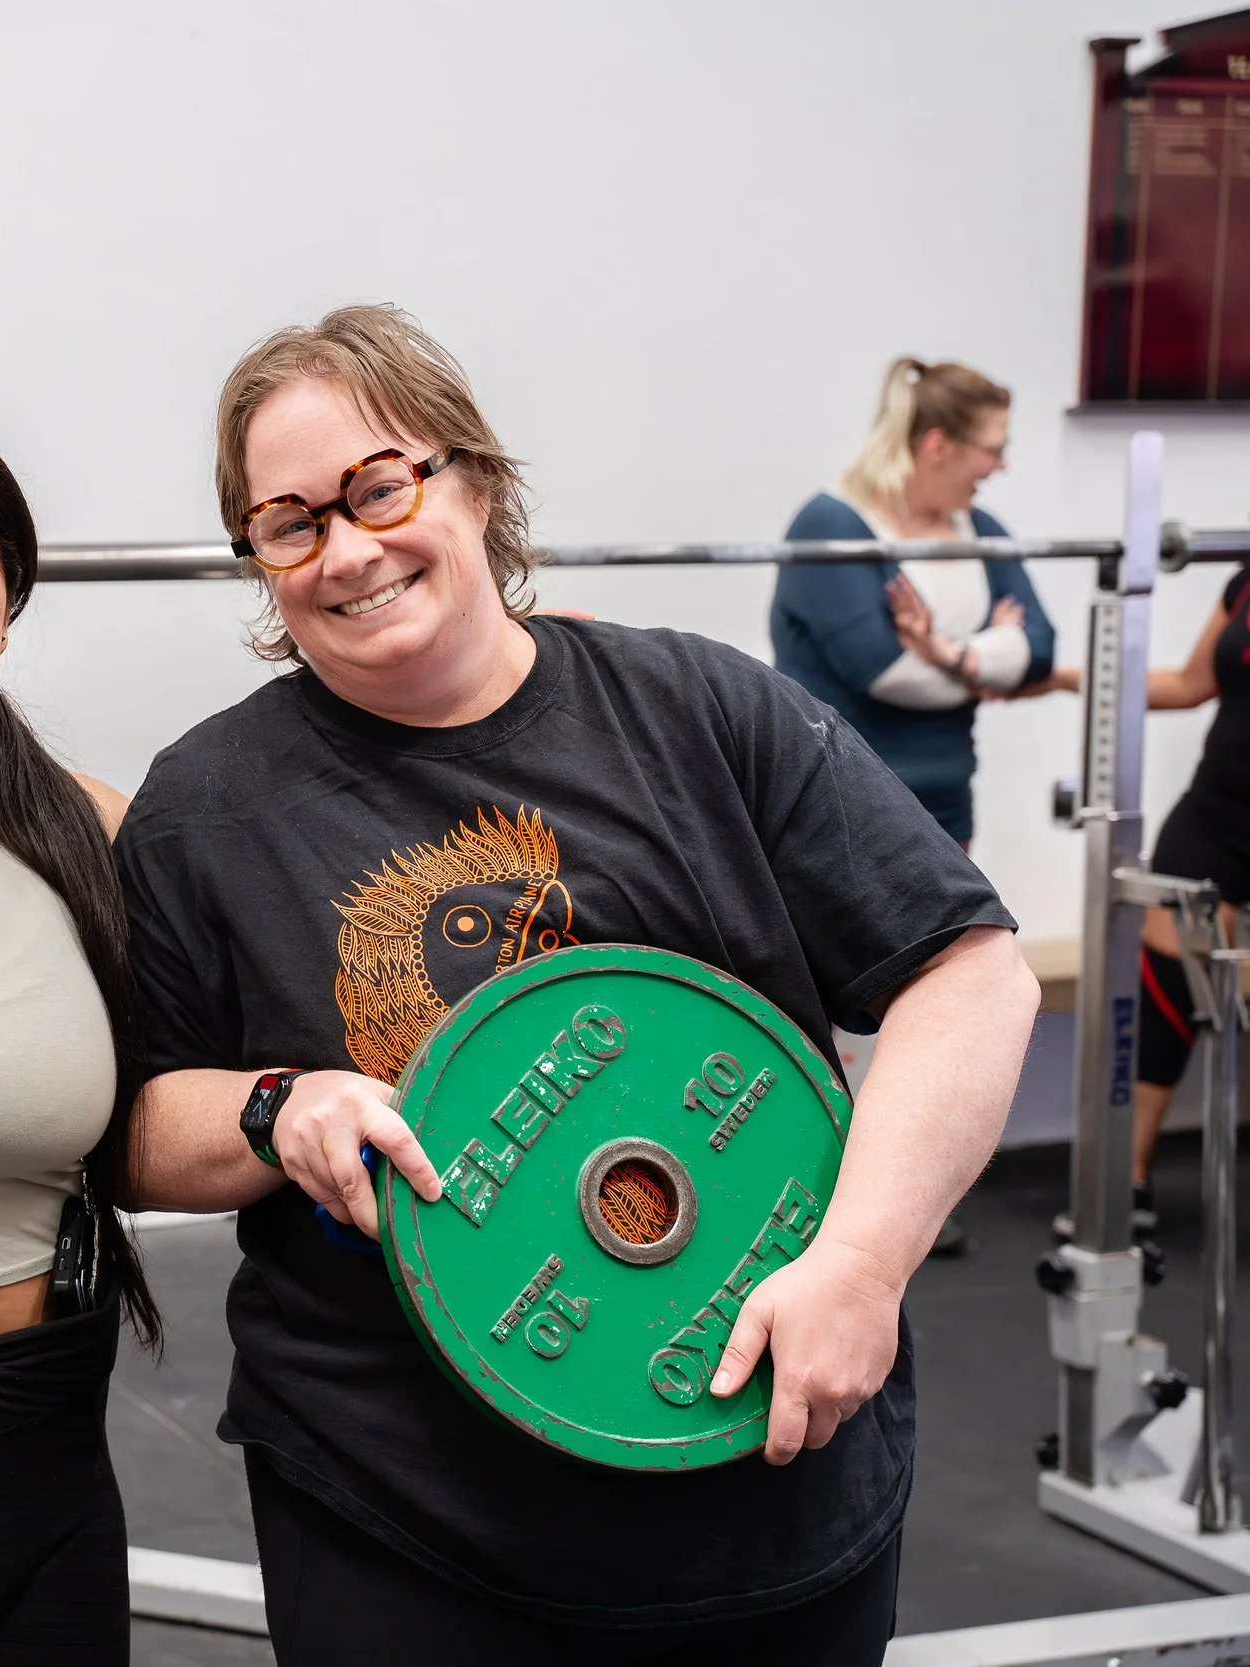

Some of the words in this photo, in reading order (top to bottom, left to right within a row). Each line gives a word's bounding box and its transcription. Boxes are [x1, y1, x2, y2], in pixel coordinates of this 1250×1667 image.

[440, 1004, 627, 1229] ELEIKO
[684, 1051, 745, 1118] 10
[709, 1067, 777, 1152] SWEDEN
[489, 1253, 565, 1343] SWEDEN
[525, 1289, 589, 1358] 10
